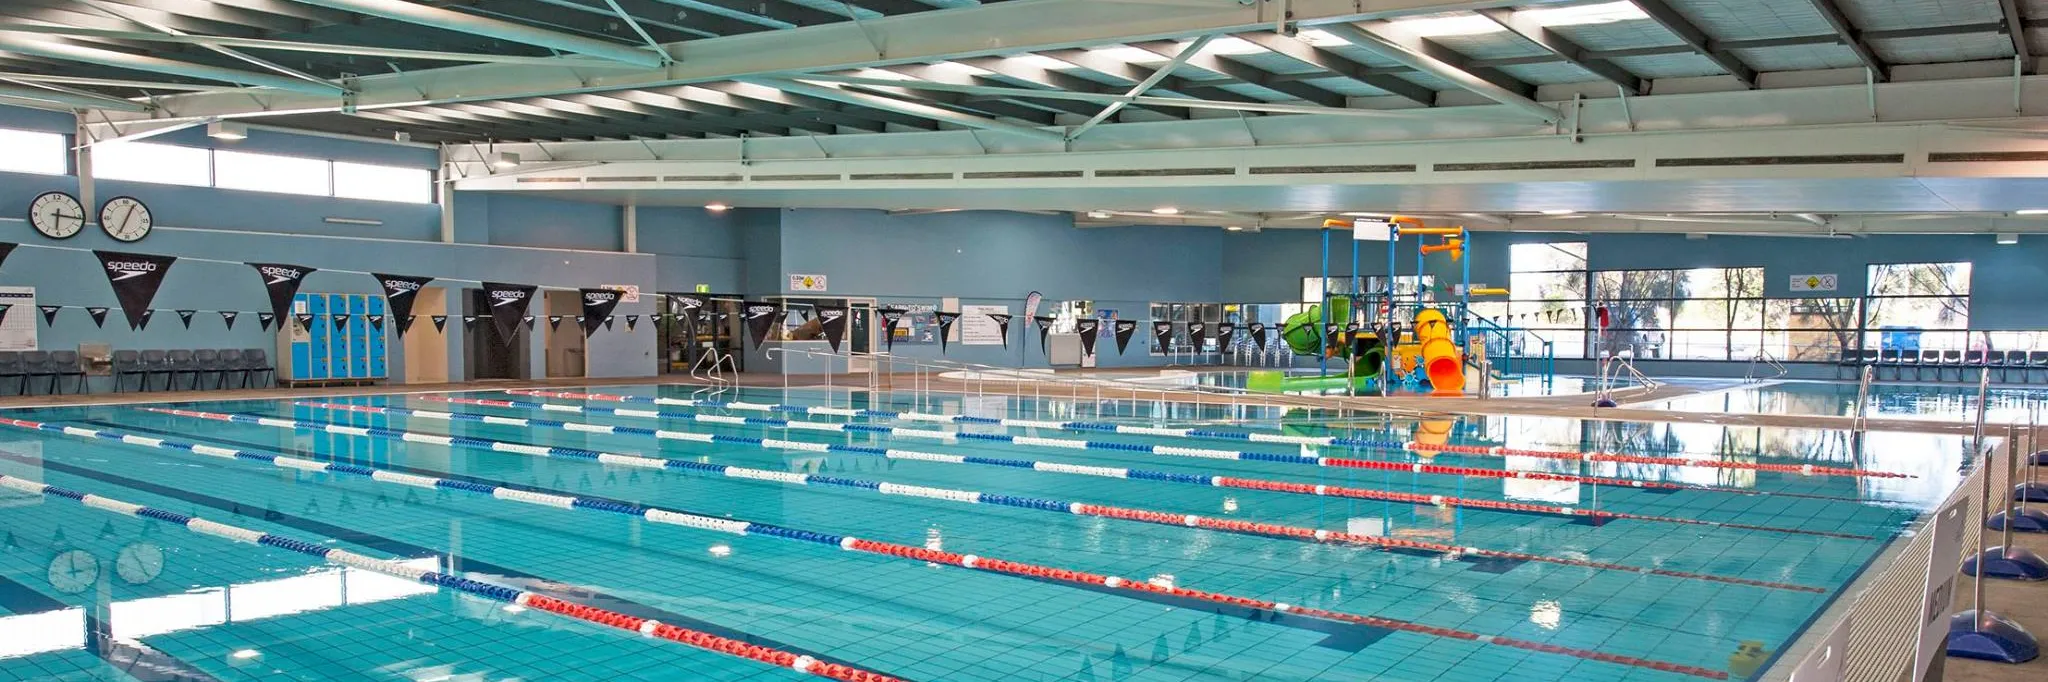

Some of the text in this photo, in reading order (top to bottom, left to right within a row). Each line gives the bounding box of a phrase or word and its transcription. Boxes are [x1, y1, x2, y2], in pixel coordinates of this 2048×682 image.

[107, 260, 157, 272] speedo
[262, 266, 300, 280] speedo
[384, 278, 420, 290] speedo
[492, 290, 524, 299] speedo
[585, 292, 614, 300] speedo
[678, 296, 702, 307] speedo
[749, 305, 774, 313] speedo
